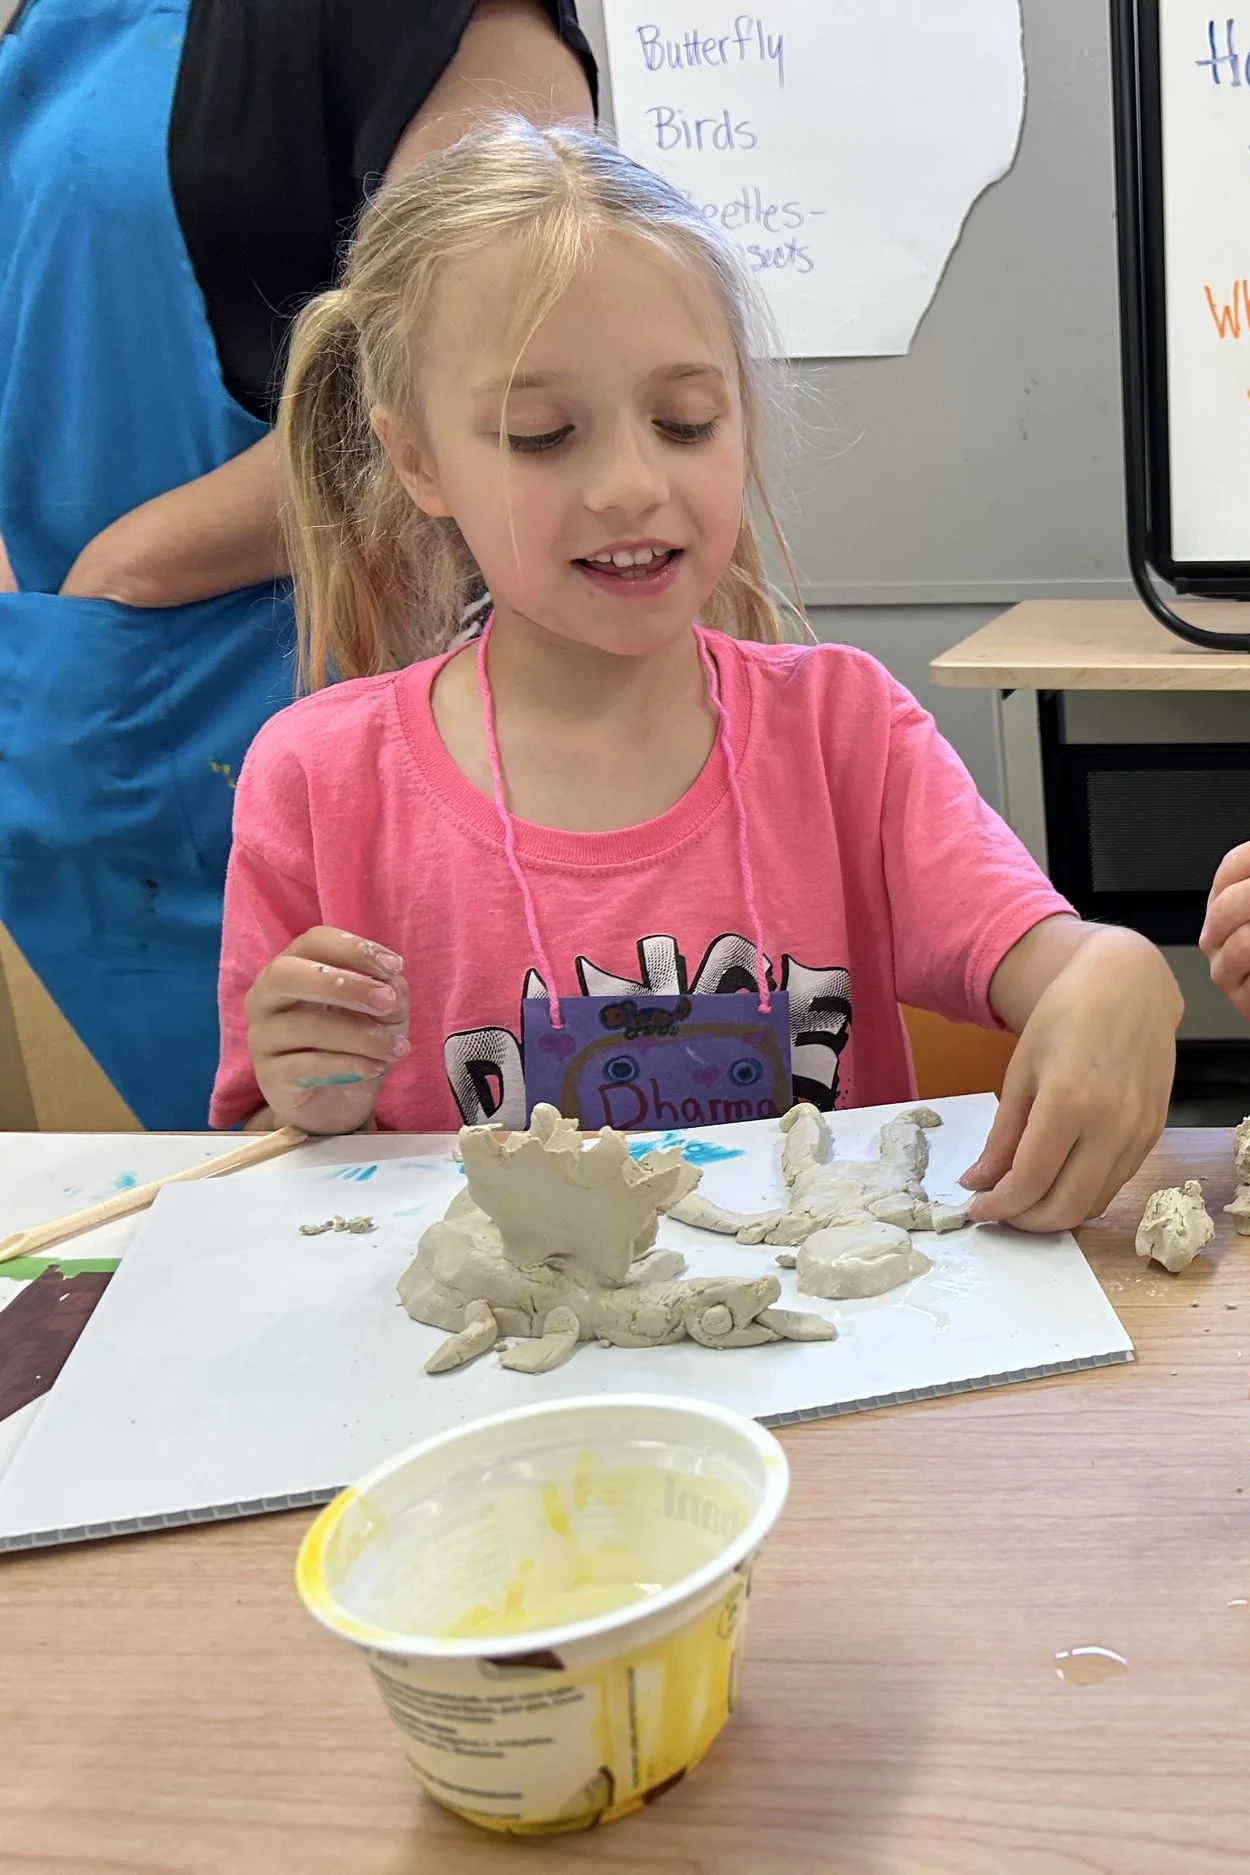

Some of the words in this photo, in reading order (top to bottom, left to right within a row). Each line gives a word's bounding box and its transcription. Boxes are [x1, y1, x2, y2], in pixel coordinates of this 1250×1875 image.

[636, 15, 785, 88] Butterfly
[646, 106, 757, 151] Birds
[684, 185, 828, 232] eetles-
[735, 236, 814, 274] sects
[598, 1077, 783, 1131] Dharma
